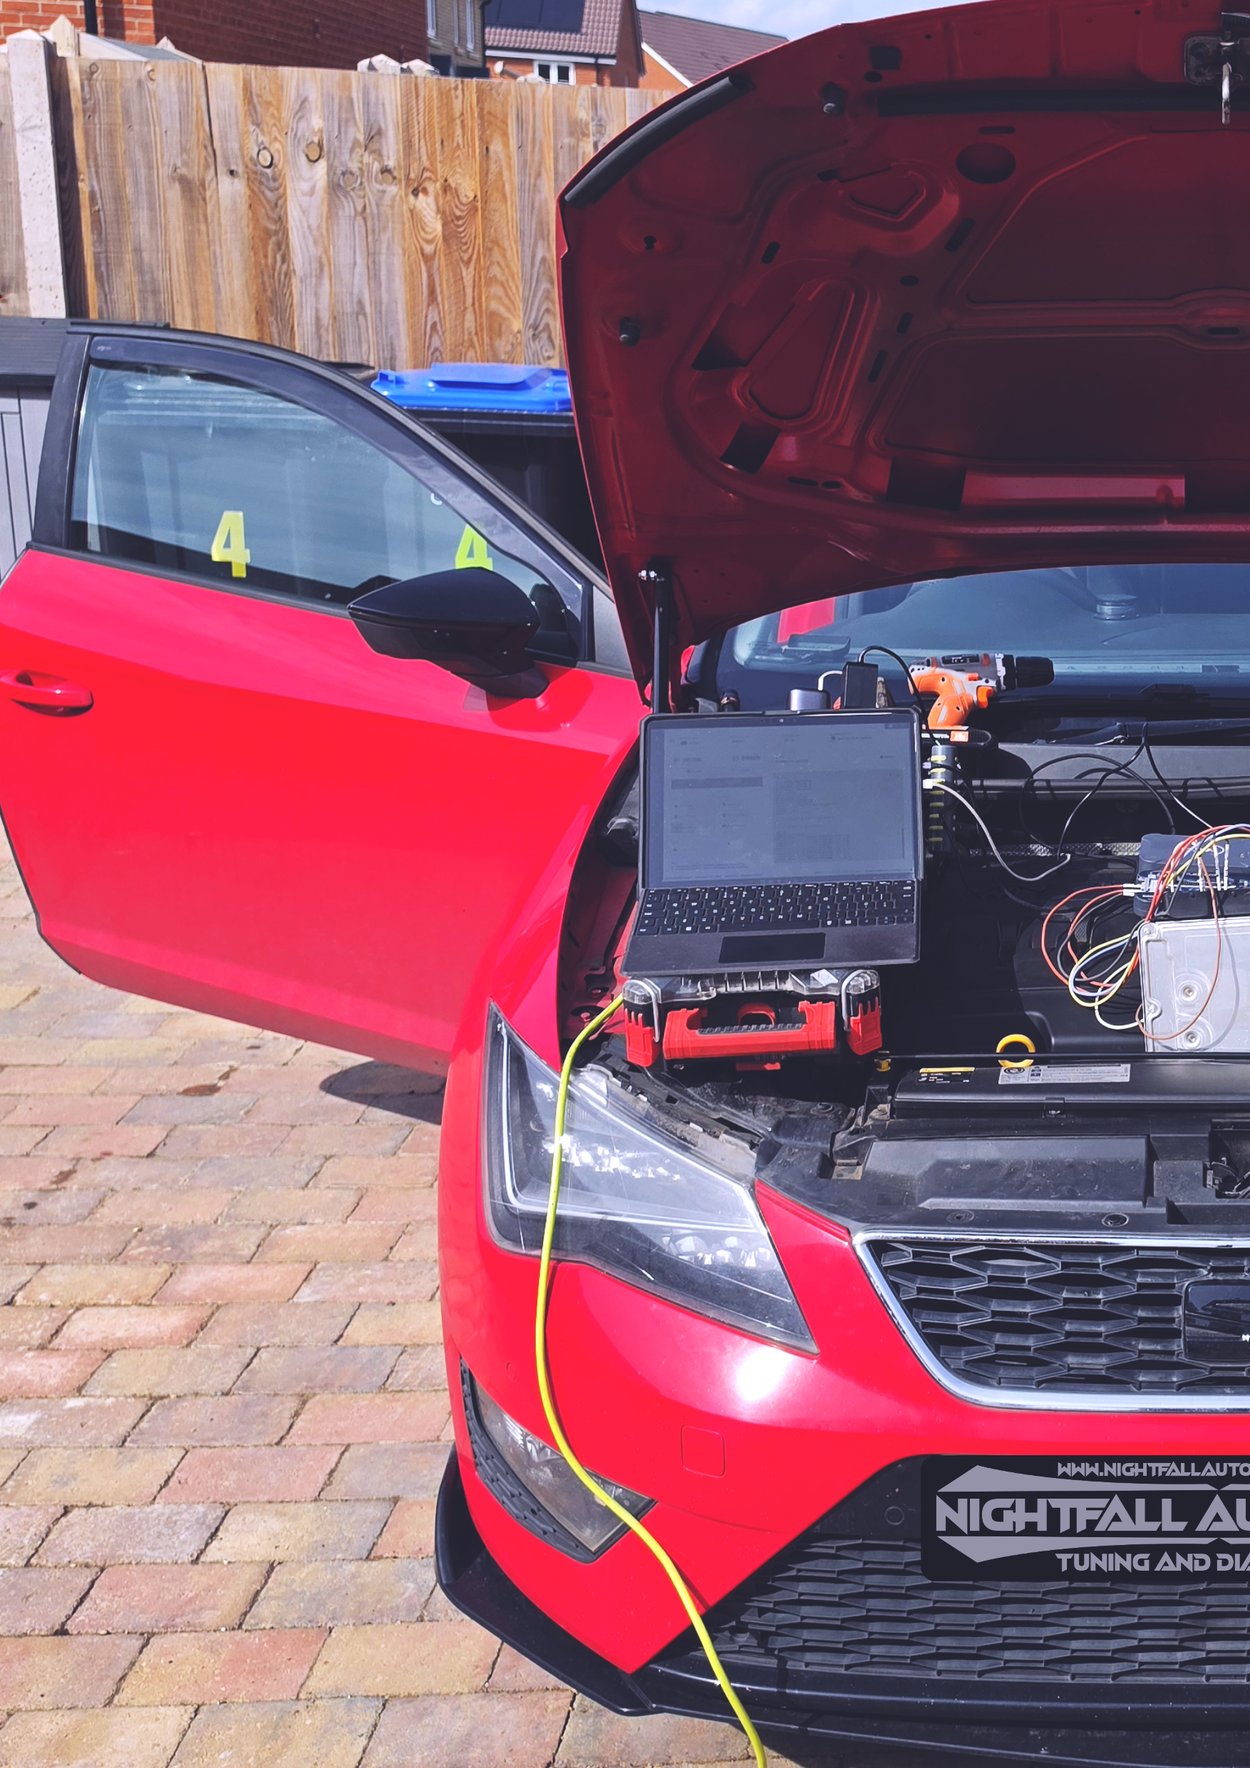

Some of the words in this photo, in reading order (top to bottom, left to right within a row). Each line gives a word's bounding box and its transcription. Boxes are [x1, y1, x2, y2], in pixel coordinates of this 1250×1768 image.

[211, 510, 250, 578] 4
[455, 523, 493, 570] 4
[936, 1494, 1188, 1535] NIGHTFALL
[1055, 1551, 1150, 1573] TUNING
[1154, 1551, 1211, 1573] AND
